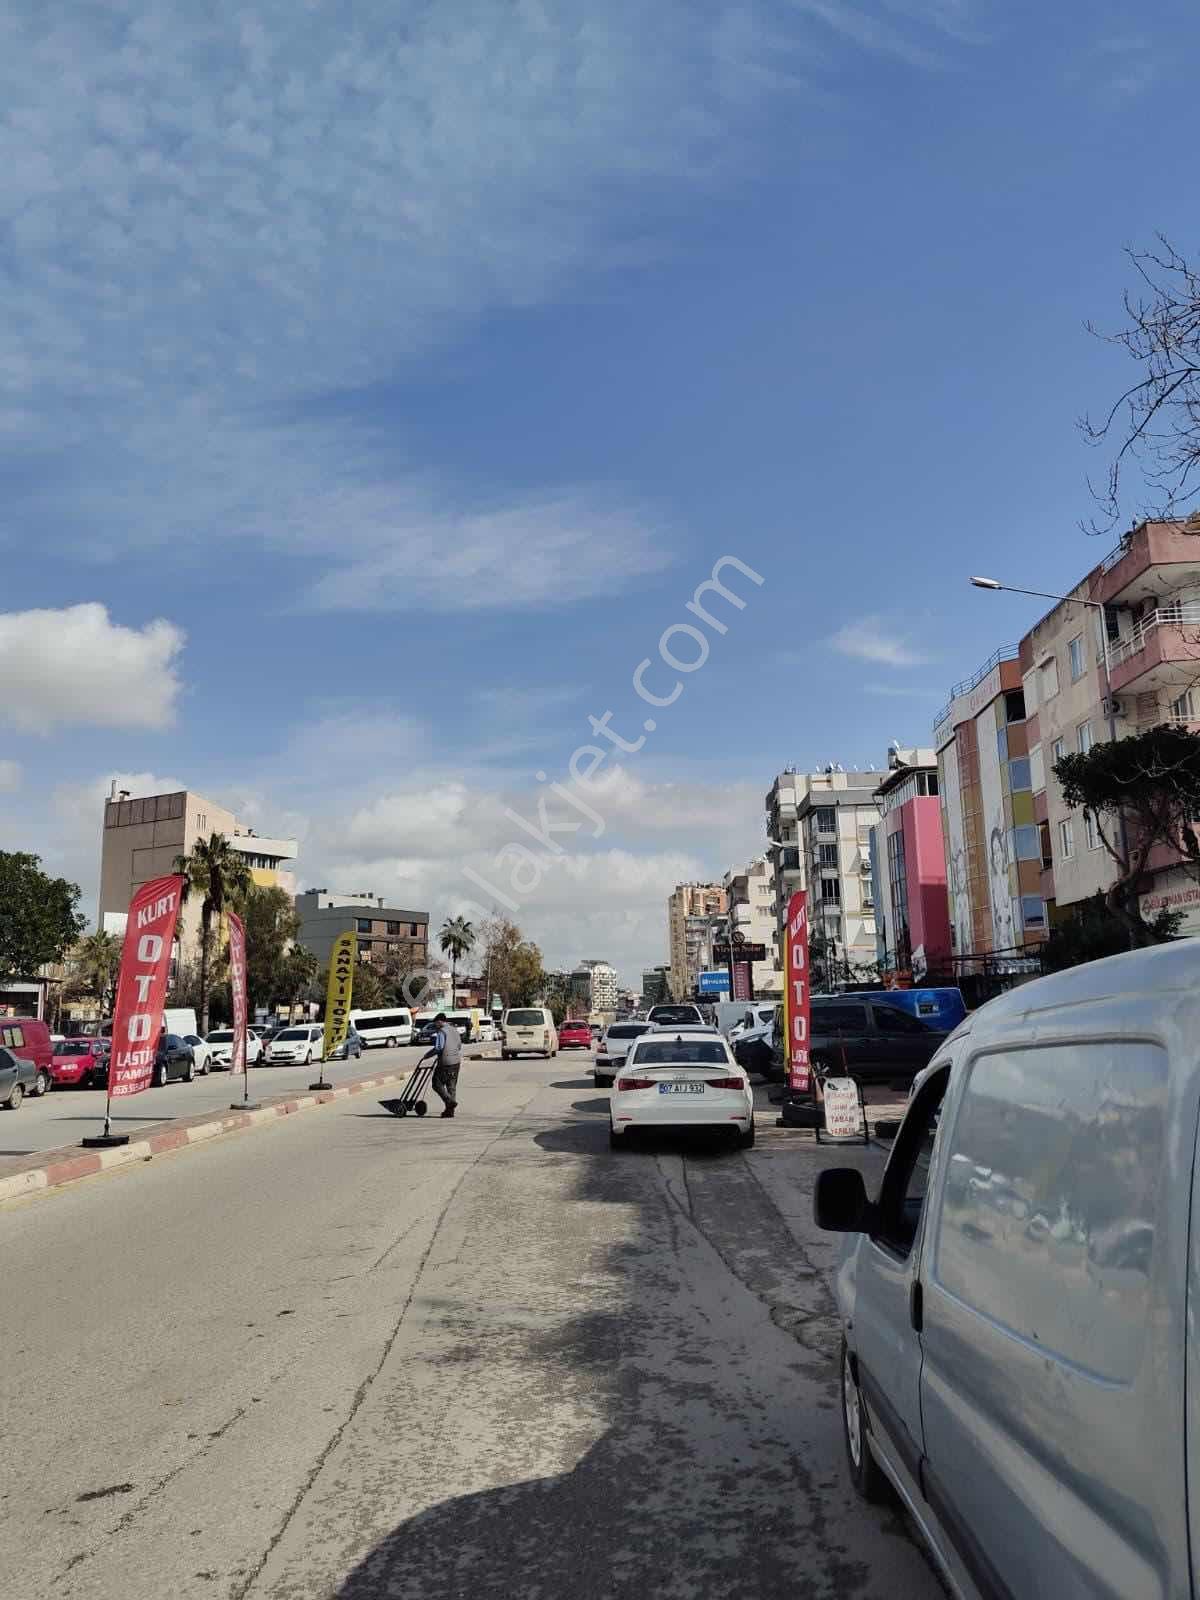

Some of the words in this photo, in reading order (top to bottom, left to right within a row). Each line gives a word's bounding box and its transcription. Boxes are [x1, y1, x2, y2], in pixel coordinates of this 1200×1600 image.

[137, 892, 176, 929] KURT
[127, 934, 163, 1043] OTO
[792, 944, 806, 1041] OTO
[114, 1064, 153, 1081] TAM
